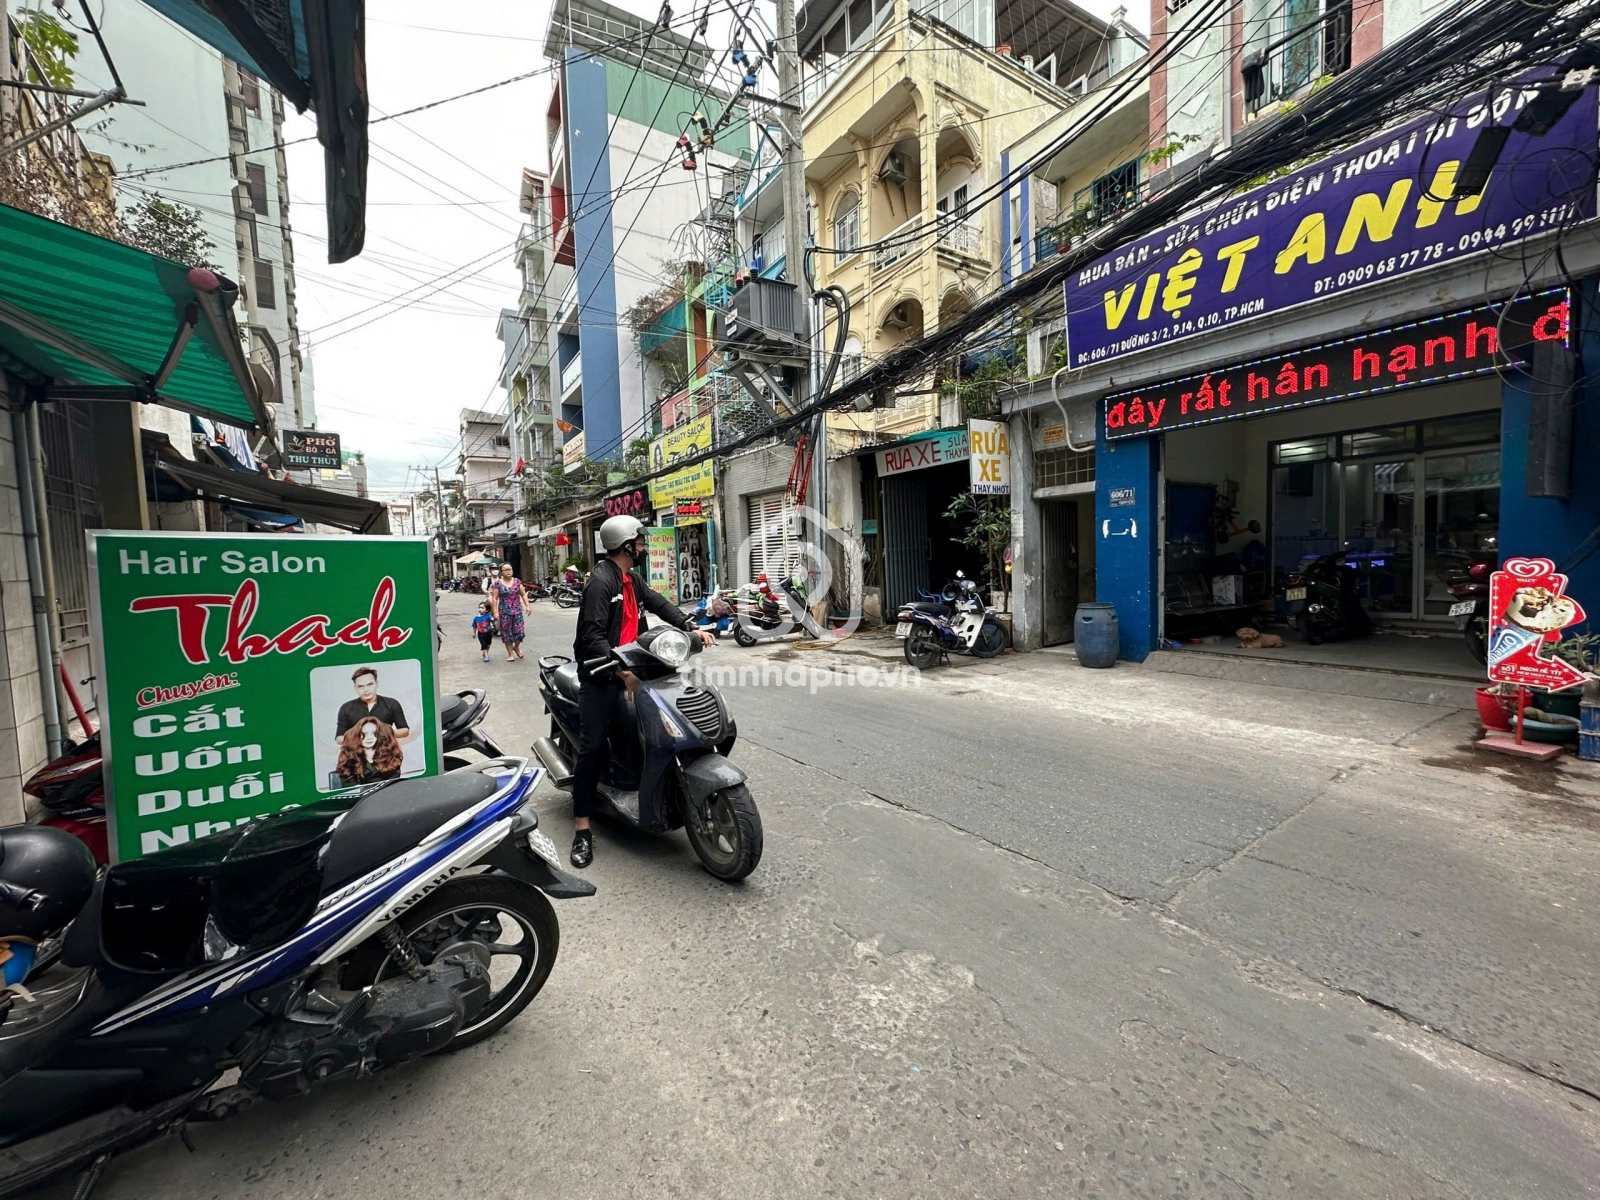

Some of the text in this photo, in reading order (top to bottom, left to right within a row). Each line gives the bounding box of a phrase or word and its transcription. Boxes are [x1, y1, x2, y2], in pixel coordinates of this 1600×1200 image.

[1079, 262, 1110, 286] MUA
[1115, 242, 1150, 272] BÁN
[1164, 225, 1200, 252] SỬA
[1204, 201, 1258, 236] CHỮA
[1265, 172, 1325, 211] ĐIỆN
[1332, 132, 1418, 184] THOẠI
[1104, 160, 1493, 330] VIỆT ANH
[1314, 277, 1334, 294] ĐT:
[1337, 261, 1374, 287] 0909
[1376, 256, 1395, 275] 68
[1399, 249, 1422, 269] 77
[1423, 242, 1444, 263] 78
[1458, 224, 1506, 251] 0944
[1512, 215, 1535, 236] 99
[1078, 298, 1264, 364] ĐC: 606/71 ĐƯỜNG 3/2, P.14, Q.10, TP.HCM
[1107, 397, 1166, 429] đây
[1180, 373, 1231, 415] rất
[1247, 362, 1328, 401] hân
[1353, 322, 1498, 384] hạnh
[305, 436, 336, 447] PHỞ
[305, 445, 318, 454] BÒ
[325, 447, 337, 455] GÀ
[668, 423, 706, 446] BEAUTY SALON
[971, 422, 1009, 455] RỬA
[288, 455, 338, 465] THU THỦY
[915, 440, 942, 466] XE
[978, 459, 1001, 482] XE
[974, 483, 1010, 494] THAY NHỚT
[119, 549, 327, 576] Hair Salon
[129, 576, 412, 665] Thạch
[136, 672, 240, 708] Chuyên:
[133, 704, 245, 738] Cắt
[135, 740, 262, 776] Uốn
[138, 772, 285, 817] Duỗi
[376, 866, 462, 923] YAMAHA
